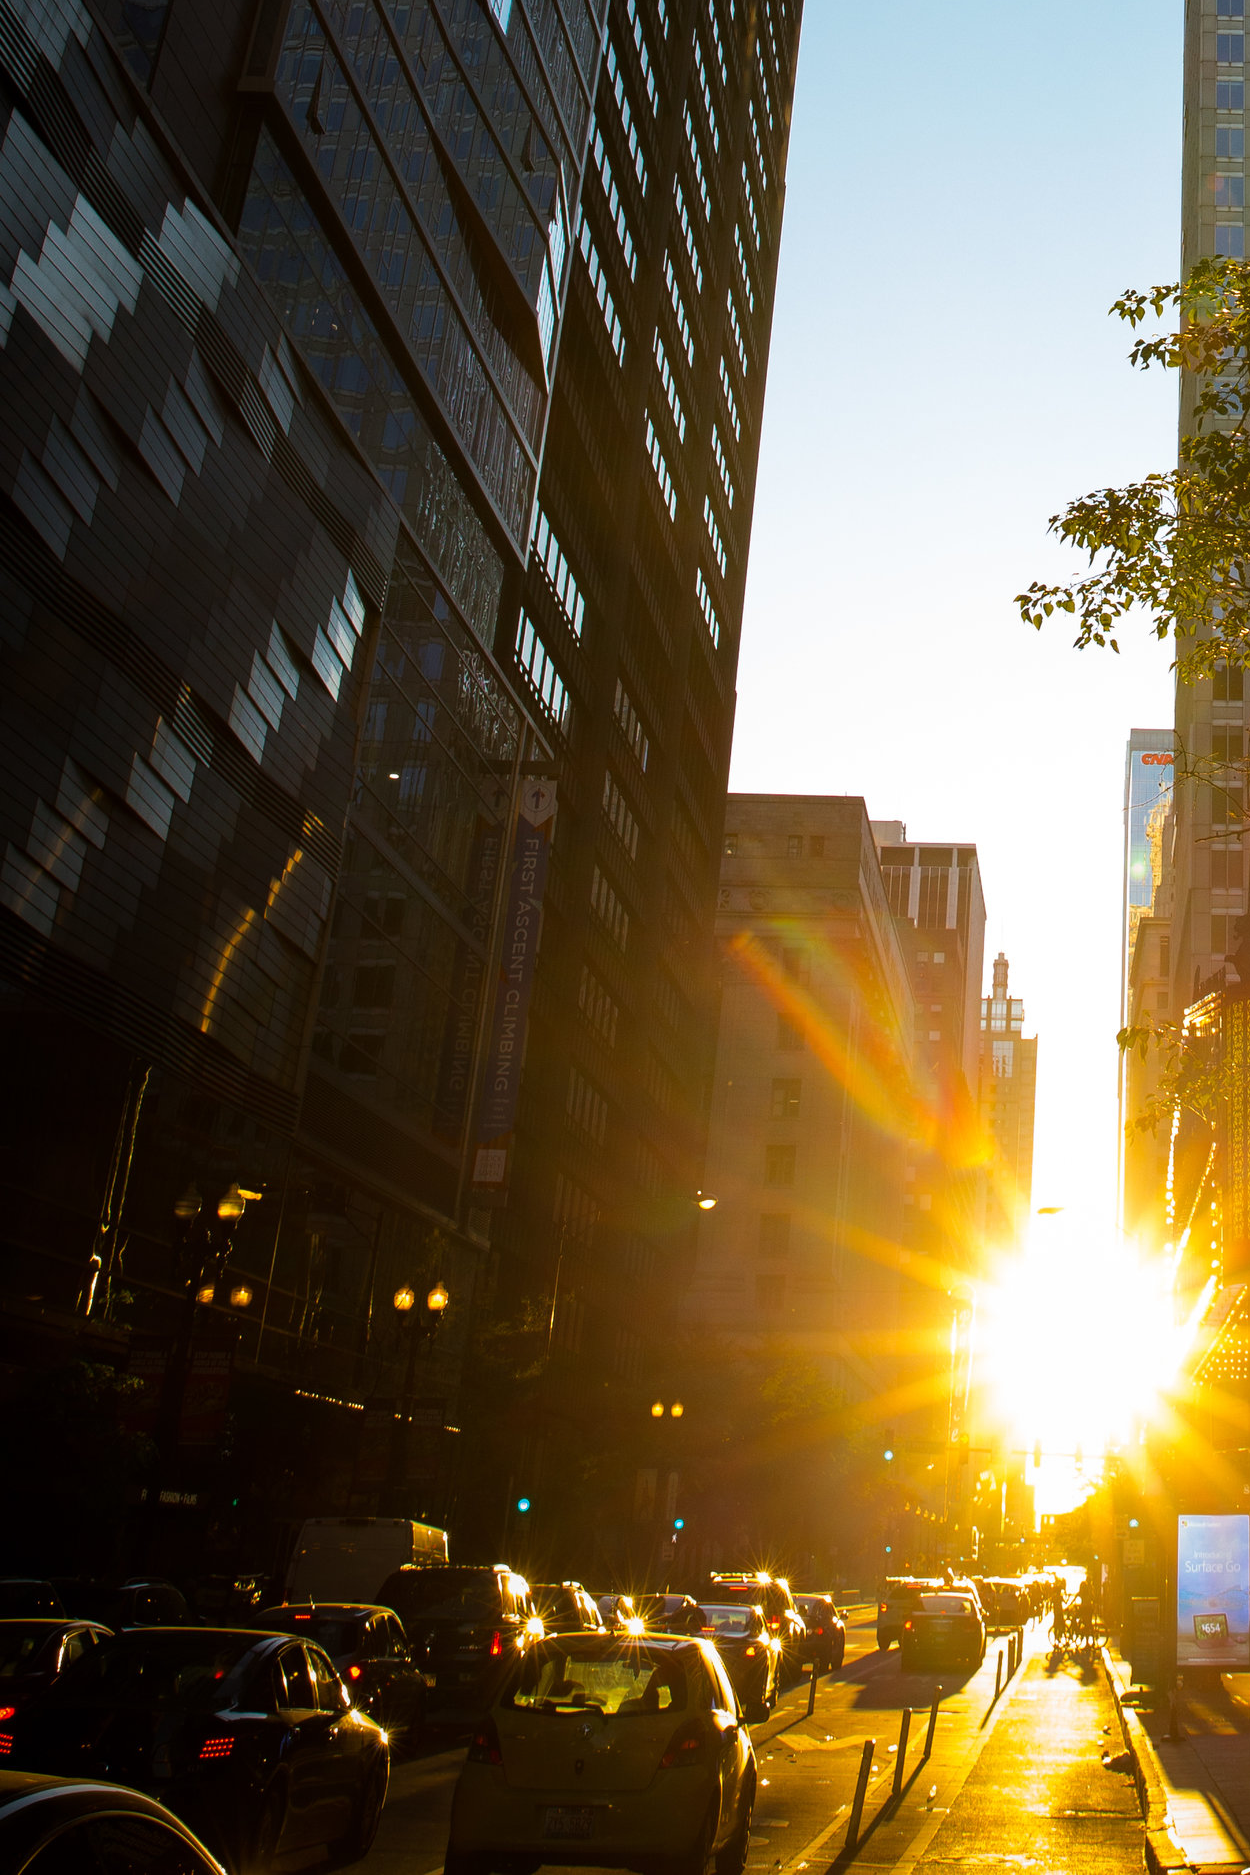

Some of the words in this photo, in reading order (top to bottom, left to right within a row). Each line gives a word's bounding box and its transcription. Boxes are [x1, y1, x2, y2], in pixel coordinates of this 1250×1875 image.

[521, 839, 540, 894] FIRST
[509, 900, 528, 982] ASCENT
[494, 989, 521, 1092] CLIMBING
[1184, 1560, 1224, 1573] Surface
[1225, 1560, 1241, 1573] Go
